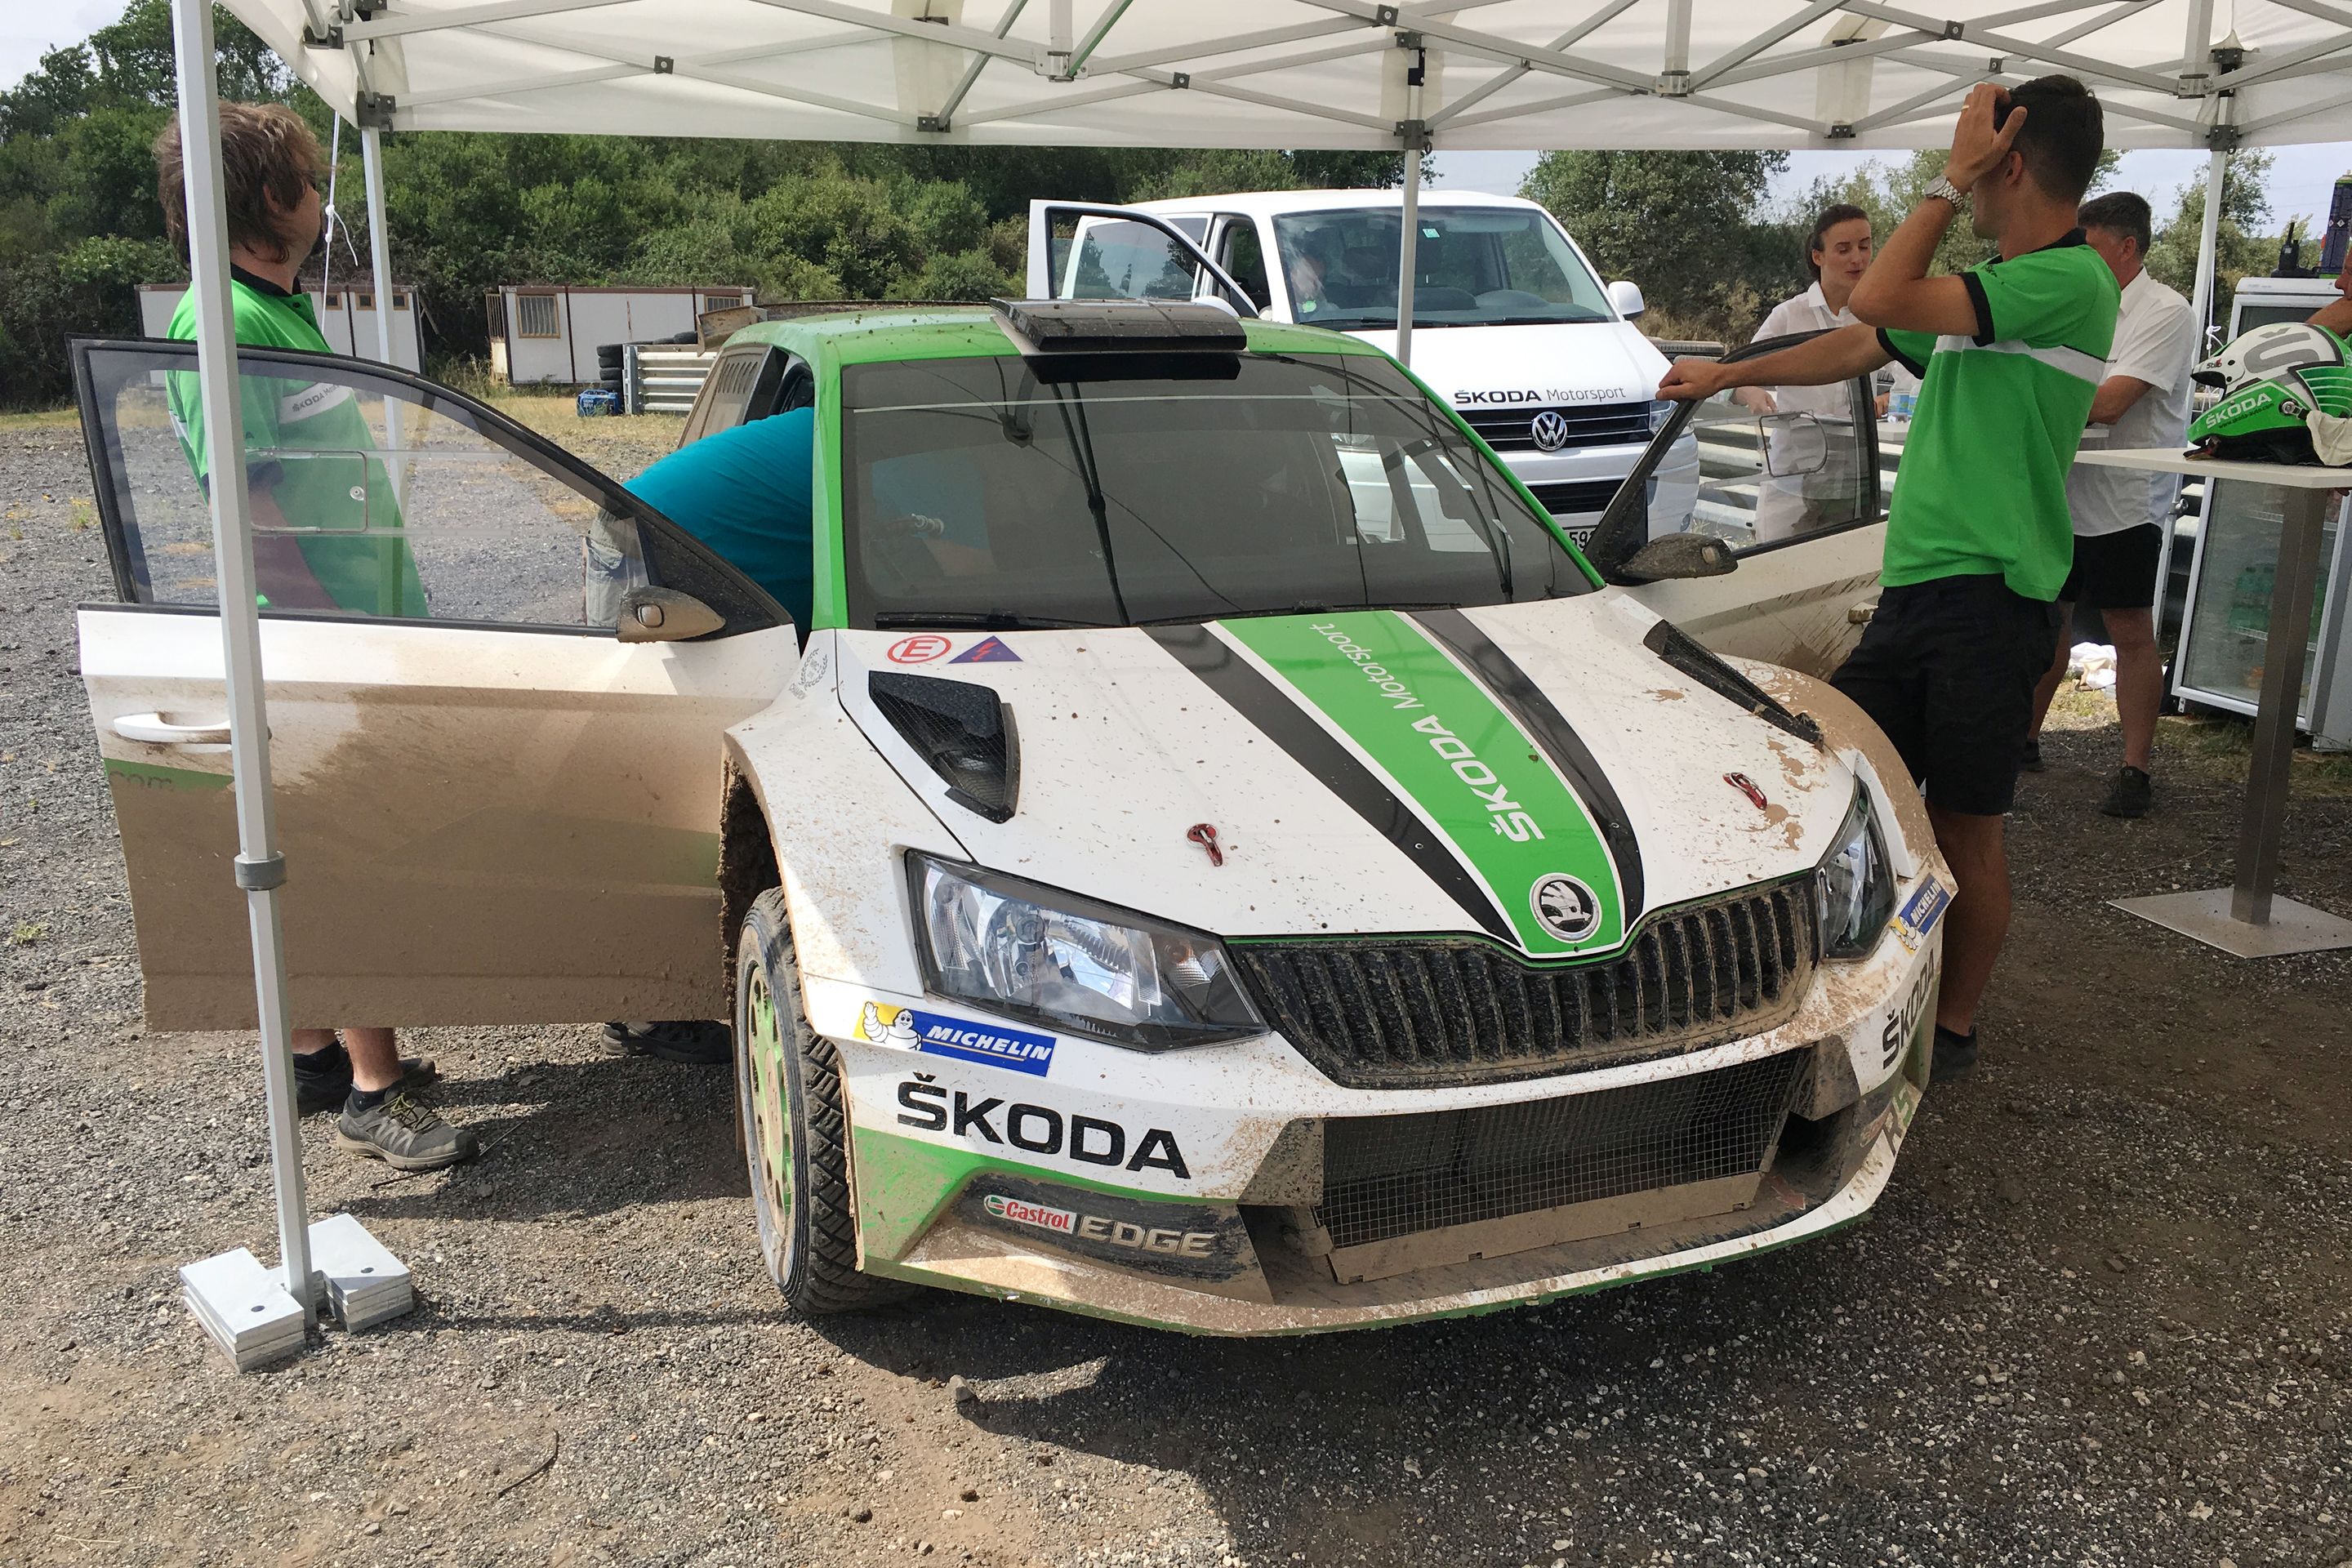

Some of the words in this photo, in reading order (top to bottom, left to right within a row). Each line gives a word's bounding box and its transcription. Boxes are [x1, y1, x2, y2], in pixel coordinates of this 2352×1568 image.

[1454, 390, 1542, 404] ŠKODA
[1546, 387, 1626, 403] Motorsport
[2206, 393, 2273, 429] ŠKODA
[1569, 531, 1595, 549] 59
[902, 639, 939, 657] E
[1309, 623, 1425, 710] Motorsport
[1410, 715, 1546, 843] ŠKODA
[1909, 880, 1941, 924] MICHELIN
[1882, 948, 1935, 1070] ŠKODA
[926, 1025, 1053, 1061] MICHELIN
[897, 1071, 1192, 1179] ŠKODA
[1004, 1200, 1071, 1232] Castrol
[1078, 1214, 1218, 1258] EDGE
